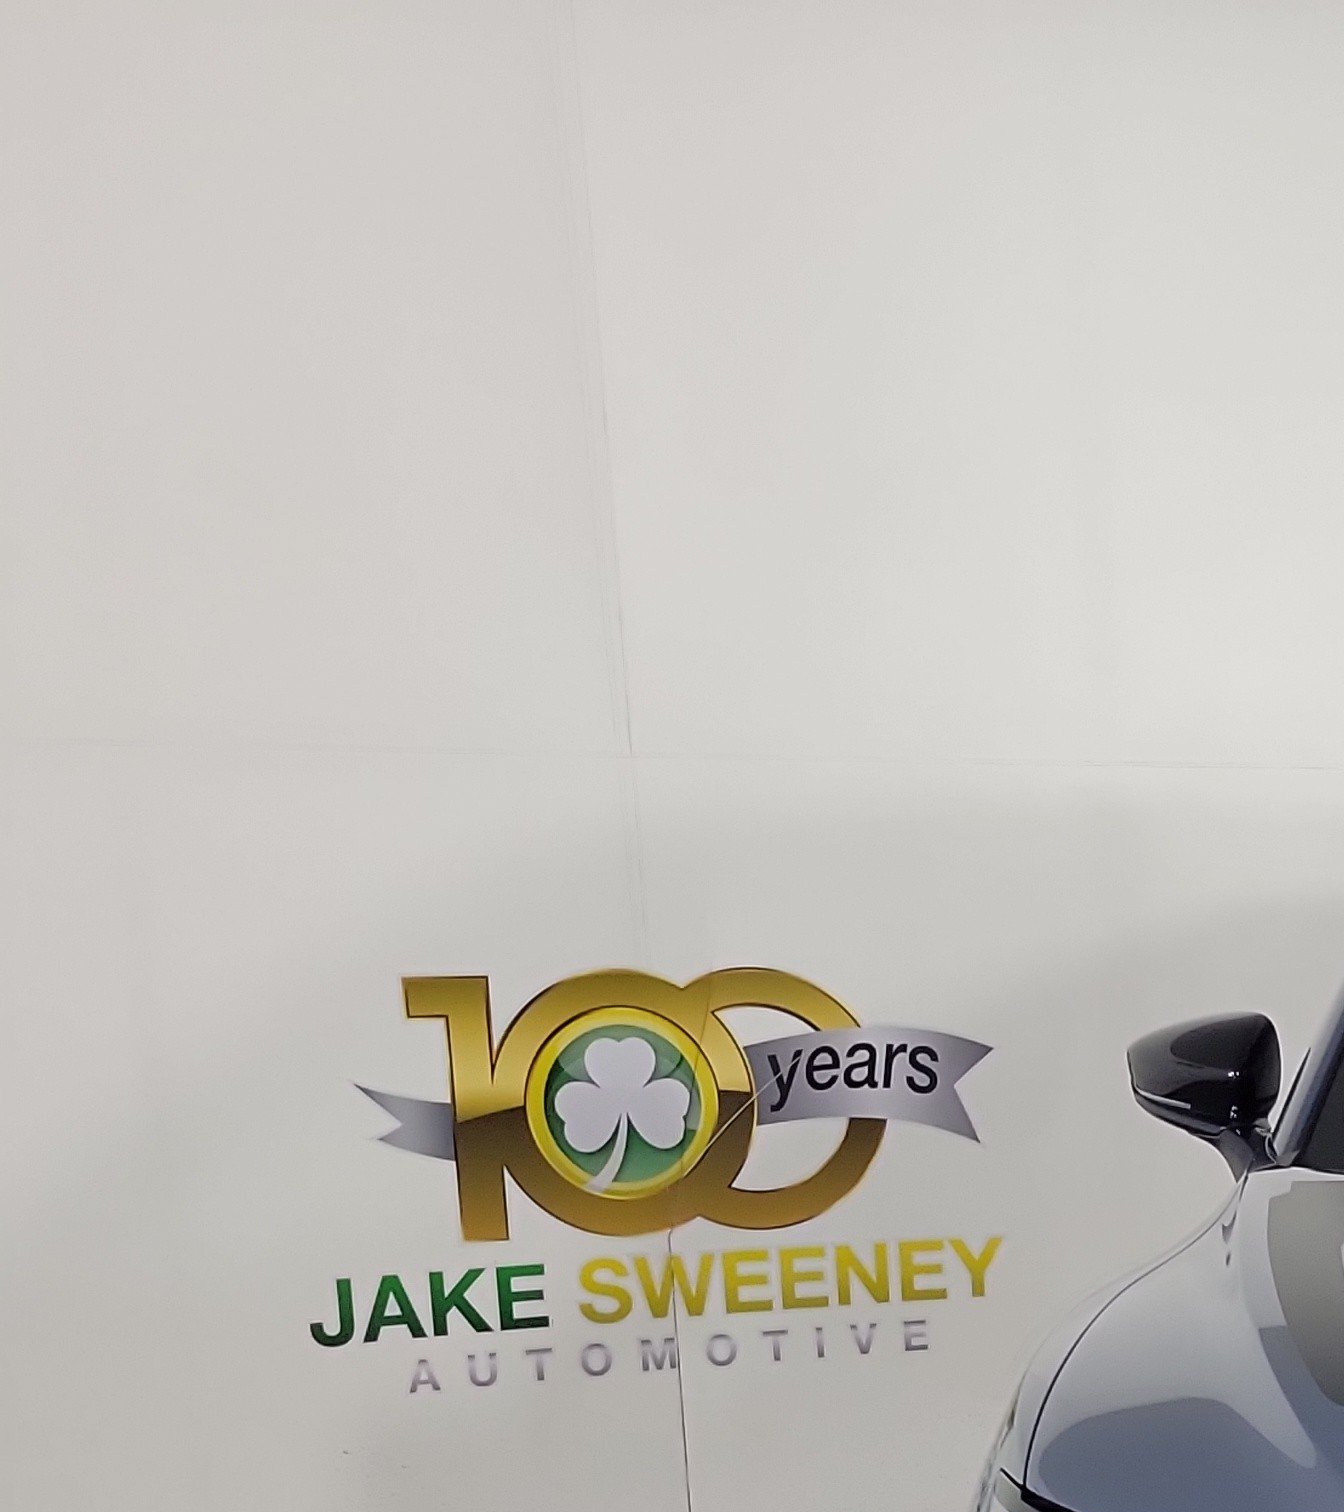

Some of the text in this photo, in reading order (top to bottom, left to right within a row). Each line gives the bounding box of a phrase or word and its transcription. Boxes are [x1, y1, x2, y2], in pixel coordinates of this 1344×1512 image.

[400, 966, 939, 1241] 100 years
[310, 1236, 1005, 1348] JAKE SWEENEY
[409, 1320, 930, 1394] AUTOMOTIVE
